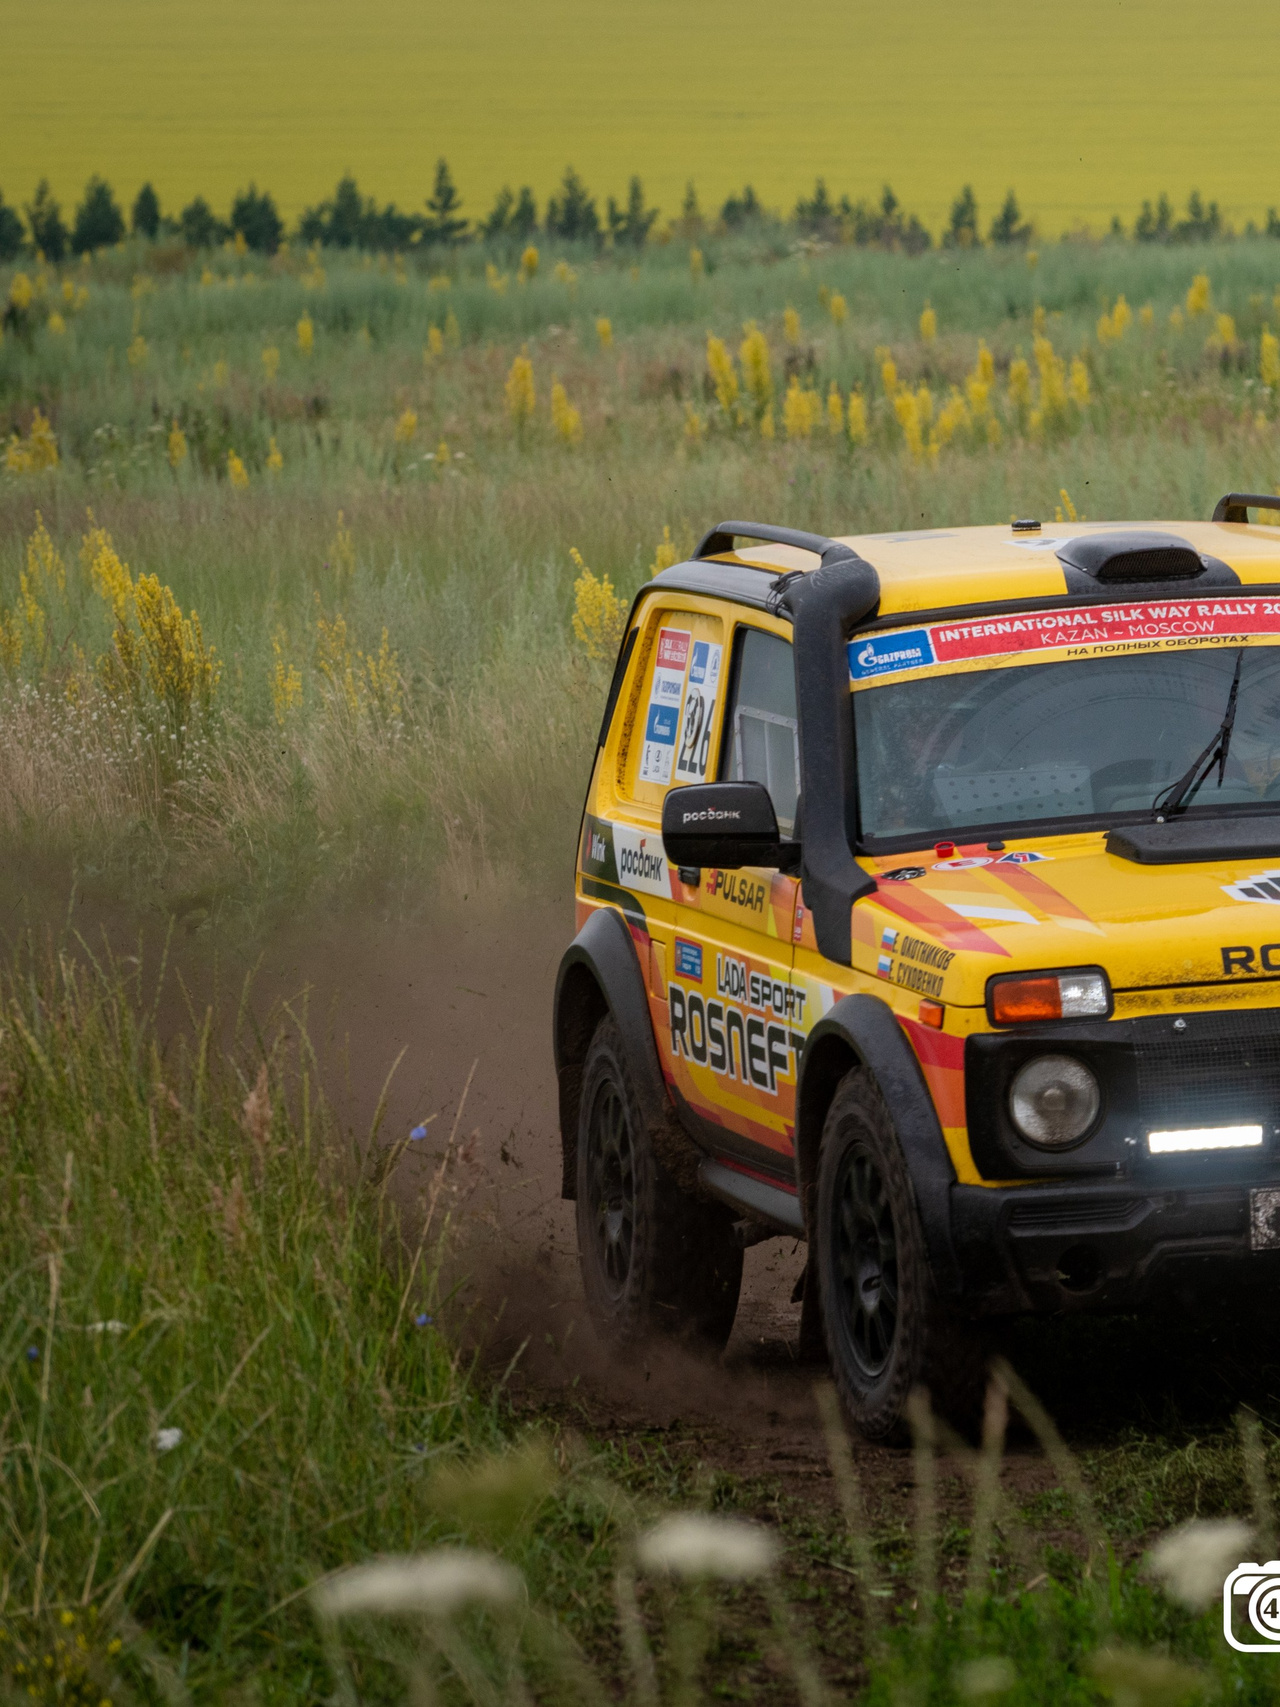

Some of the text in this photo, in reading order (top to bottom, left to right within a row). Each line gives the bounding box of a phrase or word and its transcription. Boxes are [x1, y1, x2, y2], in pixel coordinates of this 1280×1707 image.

[939, 613, 1098, 642] INTERNATIONAL
[1101, 605, 1144, 623] SILK
[1147, 605, 1192, 620] WAY
[1197, 602, 1257, 617] RALLY
[1041, 627, 1109, 645] KAZAN
[1129, 620, 1215, 638] MOSCOW
[1067, 635, 1249, 657] НА ПОЛНЫХ ОБОРОТАХ
[620, 842, 663, 881] росбанк
[716, 870, 766, 913] PULSAR
[901, 935, 956, 971] ОХОТНИКОВ
[717, 954, 748, 1005] LADA
[750, 971, 806, 1023] SPORT
[897, 962, 944, 997] СУХОВЕНКО
[668, 982, 806, 1095] ROSNEFT
